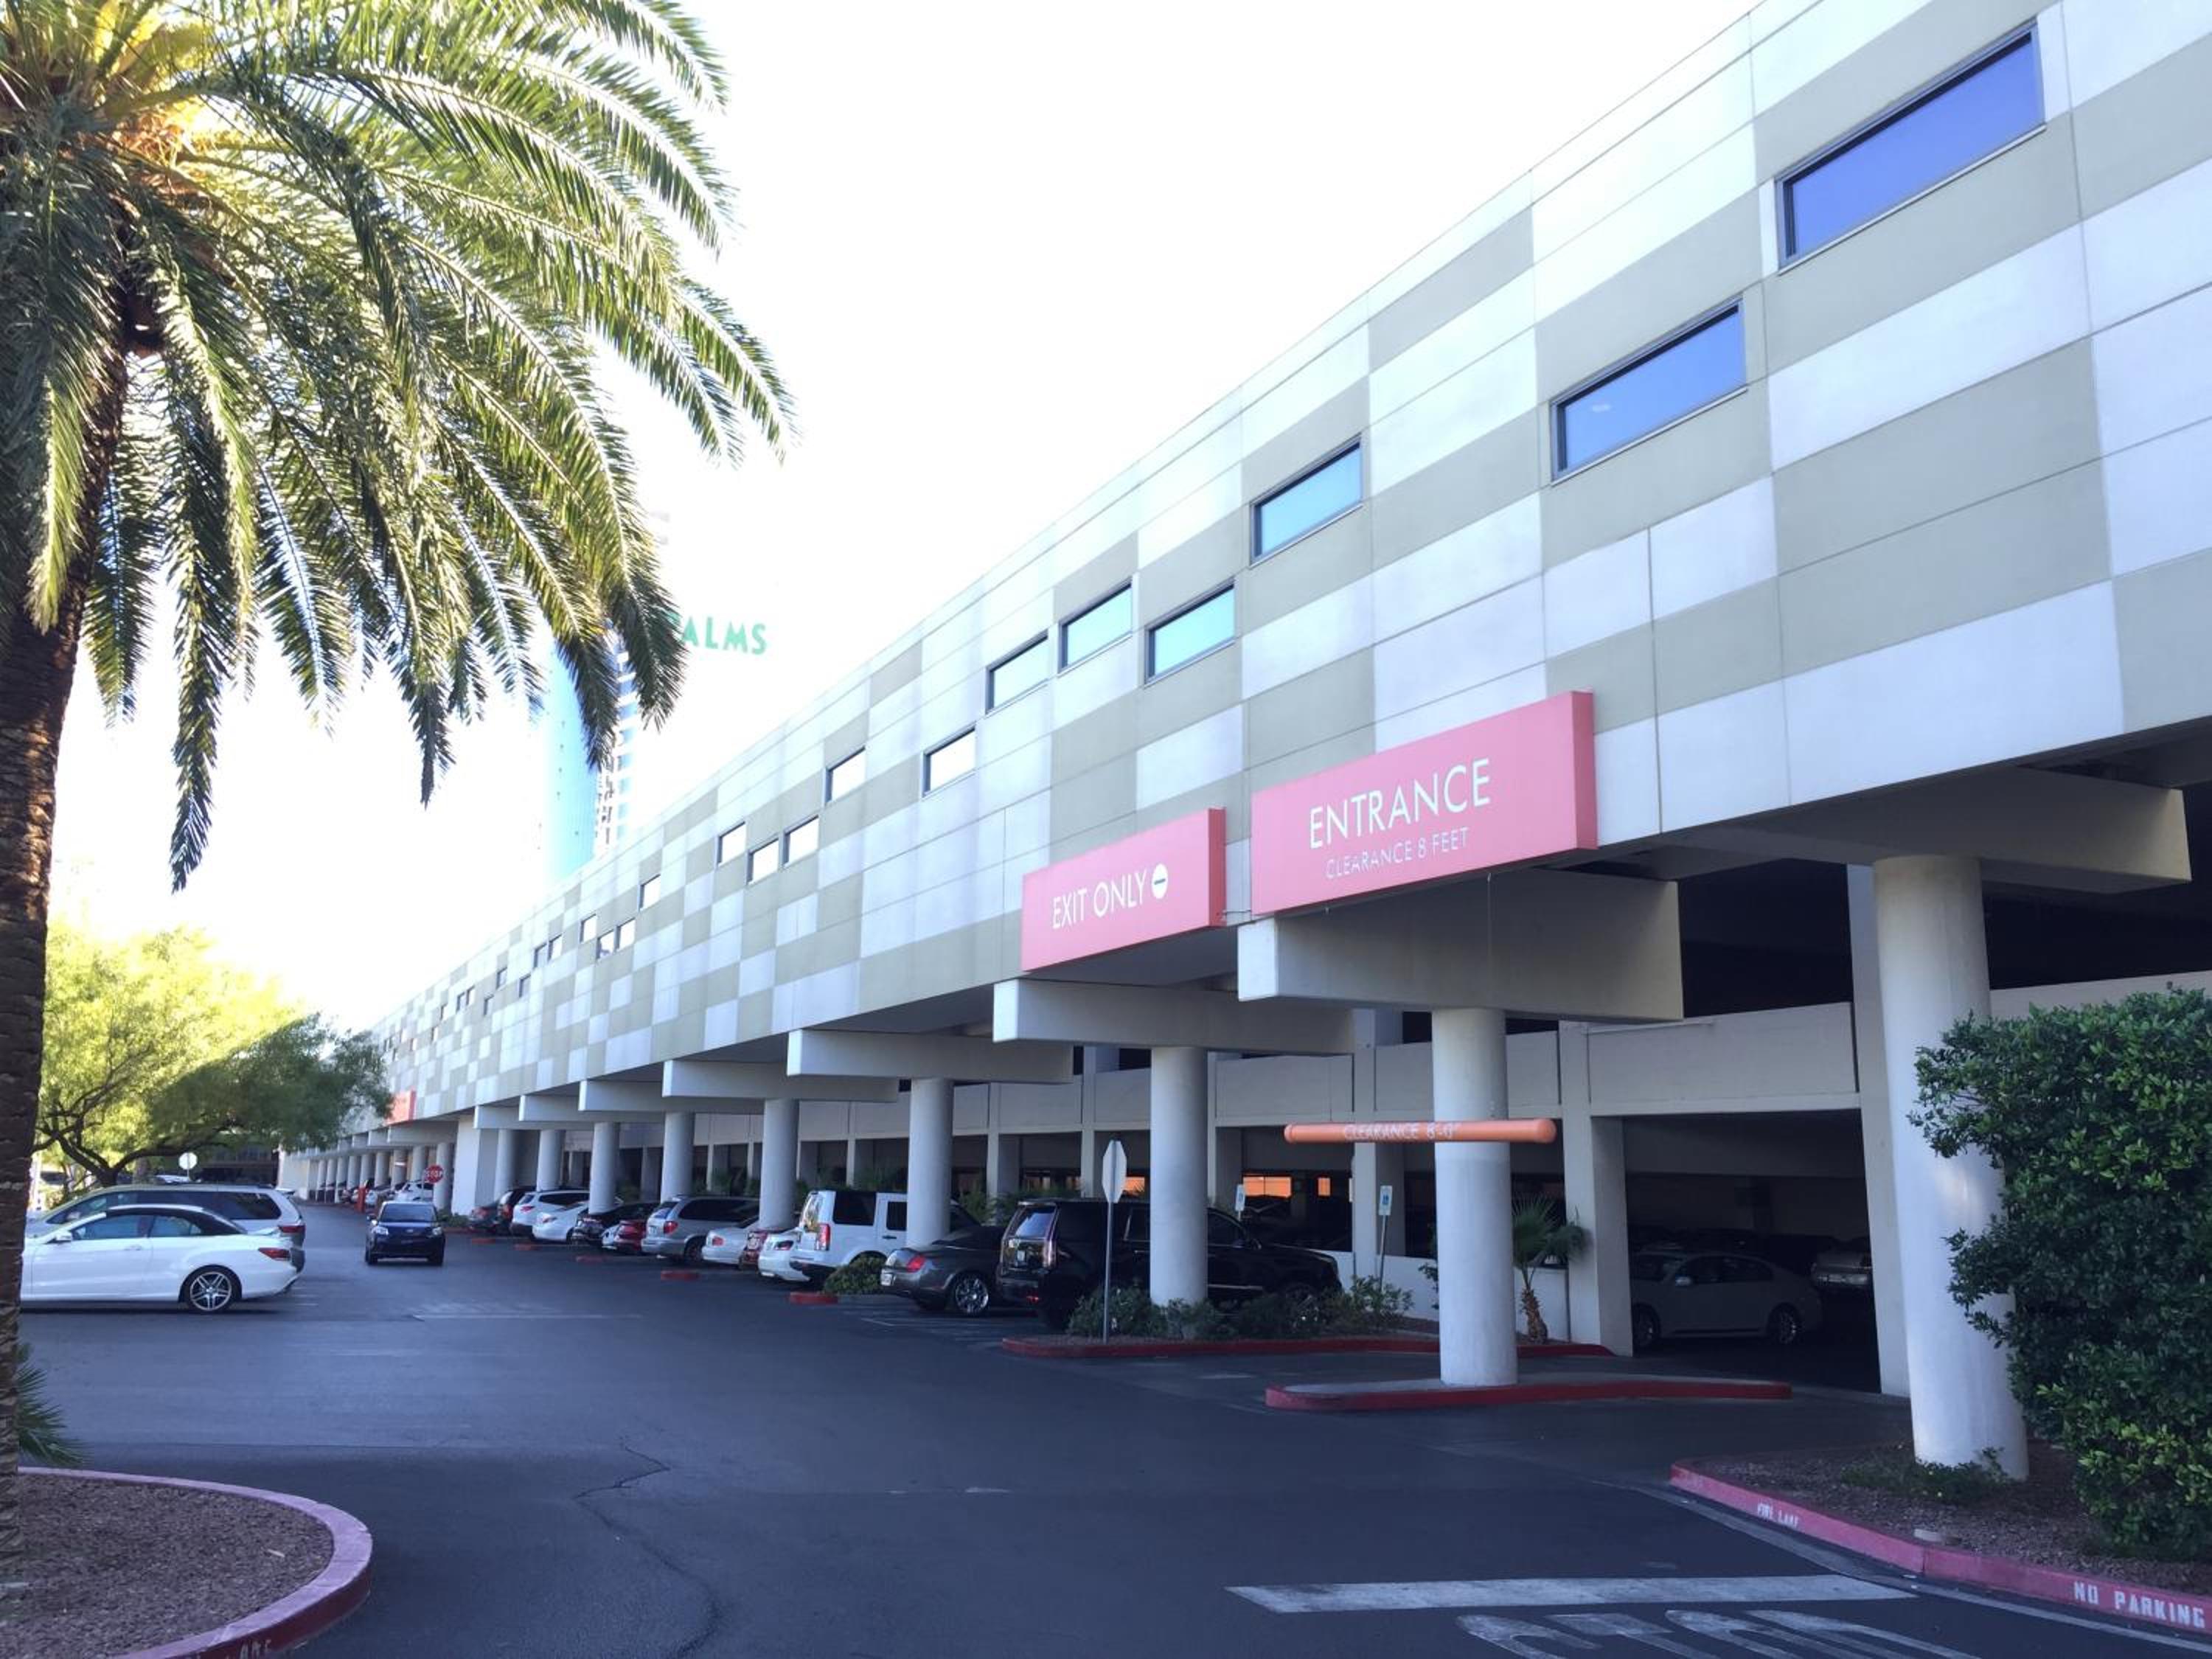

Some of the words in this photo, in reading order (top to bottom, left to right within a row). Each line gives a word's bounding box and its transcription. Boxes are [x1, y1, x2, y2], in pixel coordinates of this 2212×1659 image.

[1310, 758, 1491, 849] ENTRANCE
[1326, 840, 1413, 879] CLEARANCE
[1418, 837, 1427, 858] 8
[1432, 827, 1470, 855] FEET
[1052, 888, 1088, 929] EXIT
[1093, 869, 1147, 918] ONLY
[1344, 1123, 1419, 1141] CLEARANCE
[2074, 1581, 2098, 1604] NO
[2114, 1590, 2205, 1628] PARKING
